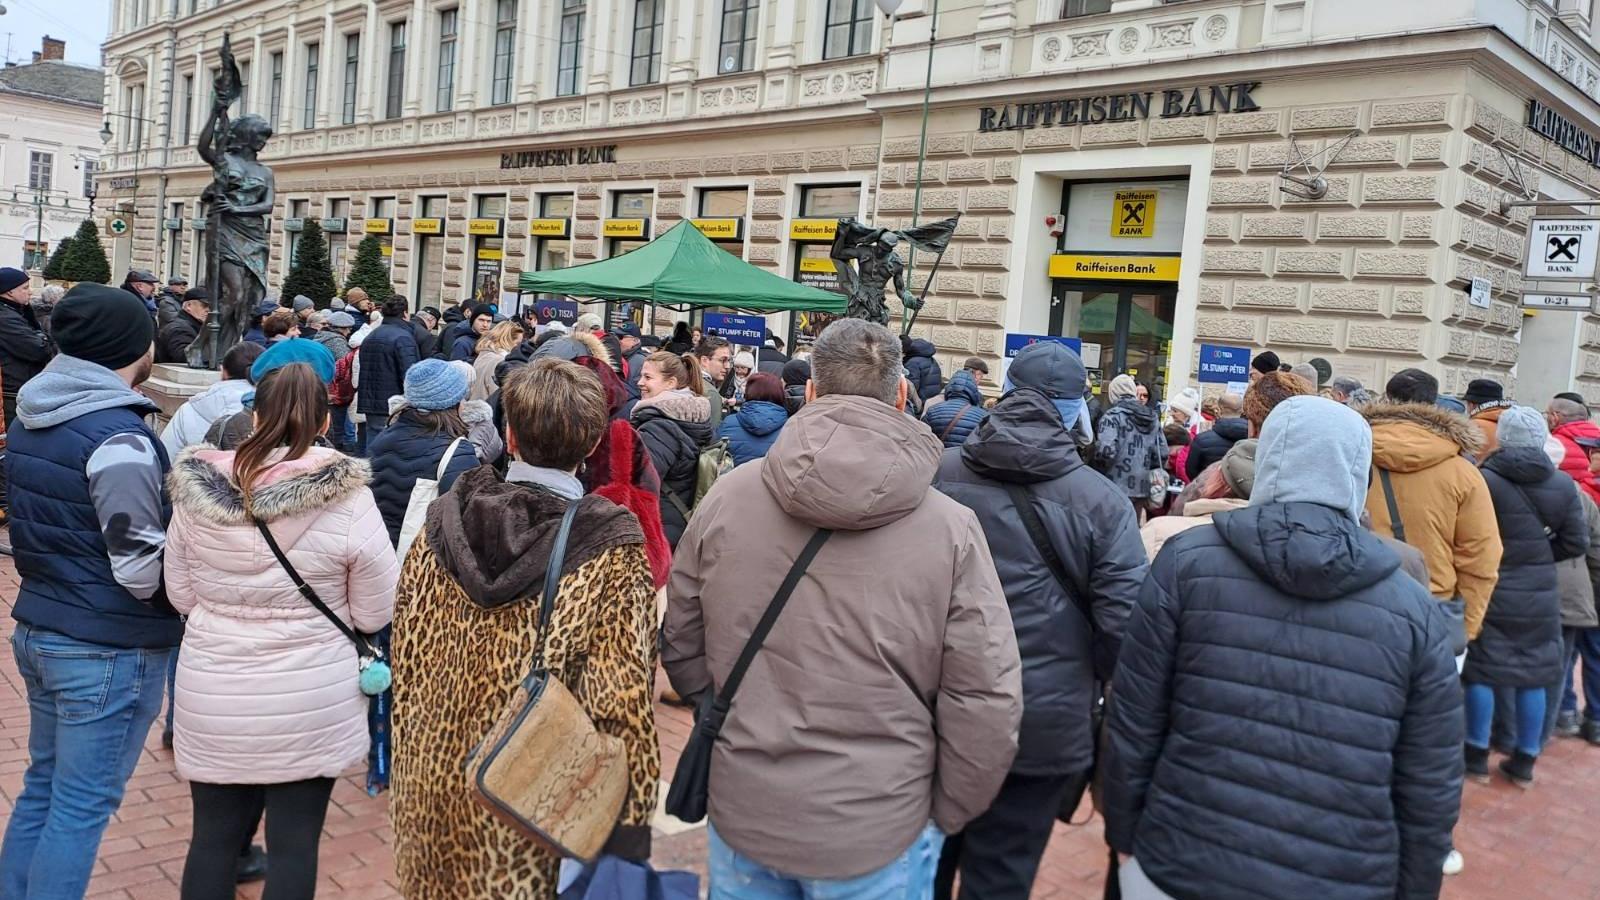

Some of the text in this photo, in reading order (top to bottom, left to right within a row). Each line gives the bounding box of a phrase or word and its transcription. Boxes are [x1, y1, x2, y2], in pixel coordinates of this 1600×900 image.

[979, 82, 1261, 133] RAIFFEISEN BANK
[1529, 99, 1594, 163] RAIFFEISEN
[501, 144, 617, 169] RAIFFEISEN BANK
[1116, 192, 1154, 200] Raiffeisen
[794, 224, 837, 234] Raiffeisen Ban
[1075, 262, 1155, 274] Raiffeisen Bank
[558, 309, 574, 319] TISZA
[718, 328, 741, 336] STUMPF
[742, 329, 761, 338] PÉTER
[1229, 363, 1246, 374] PÉTER
